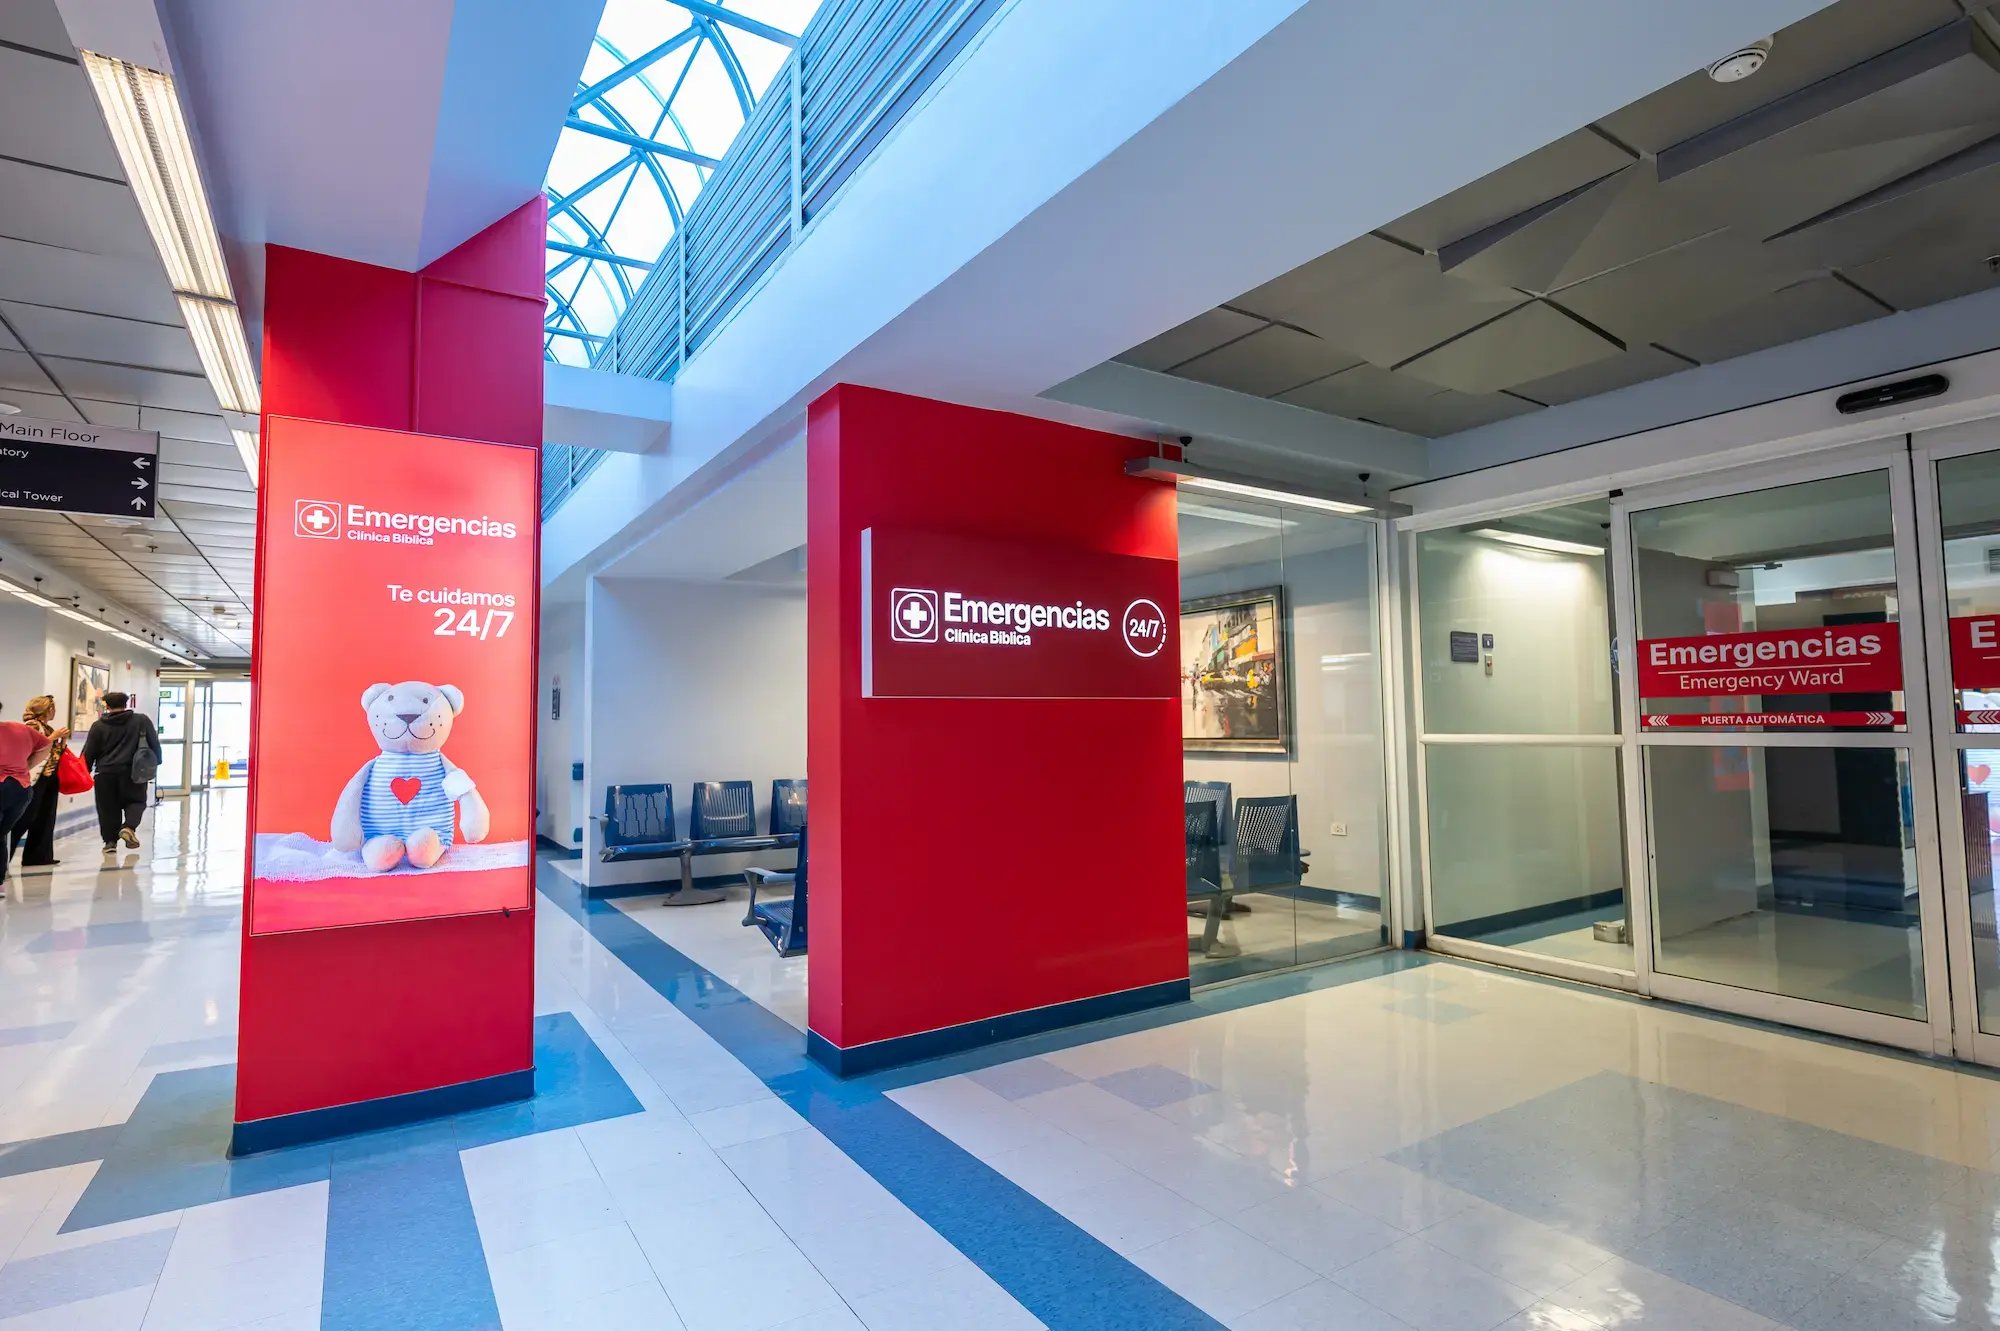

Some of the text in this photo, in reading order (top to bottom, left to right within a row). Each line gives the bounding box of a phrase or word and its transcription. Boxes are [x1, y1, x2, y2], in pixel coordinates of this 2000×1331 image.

[0, 422, 100, 443] Main Floor
[0, 447, 29, 458] tory
[23, 490, 63, 502] Tower
[347, 504, 517, 539] Emergencias
[387, 584, 516, 607] Te cuidamos
[433, 607, 515, 641] 24/7
[944, 591, 1110, 634] Emergencias
[1129, 618, 1160, 639] 24/7
[1650, 630, 1882, 668] Emergencias
[1680, 668, 1843, 692] Emergency Ward
[1701, 712, 1825, 725] PUERTA AUTOMÁTICA
